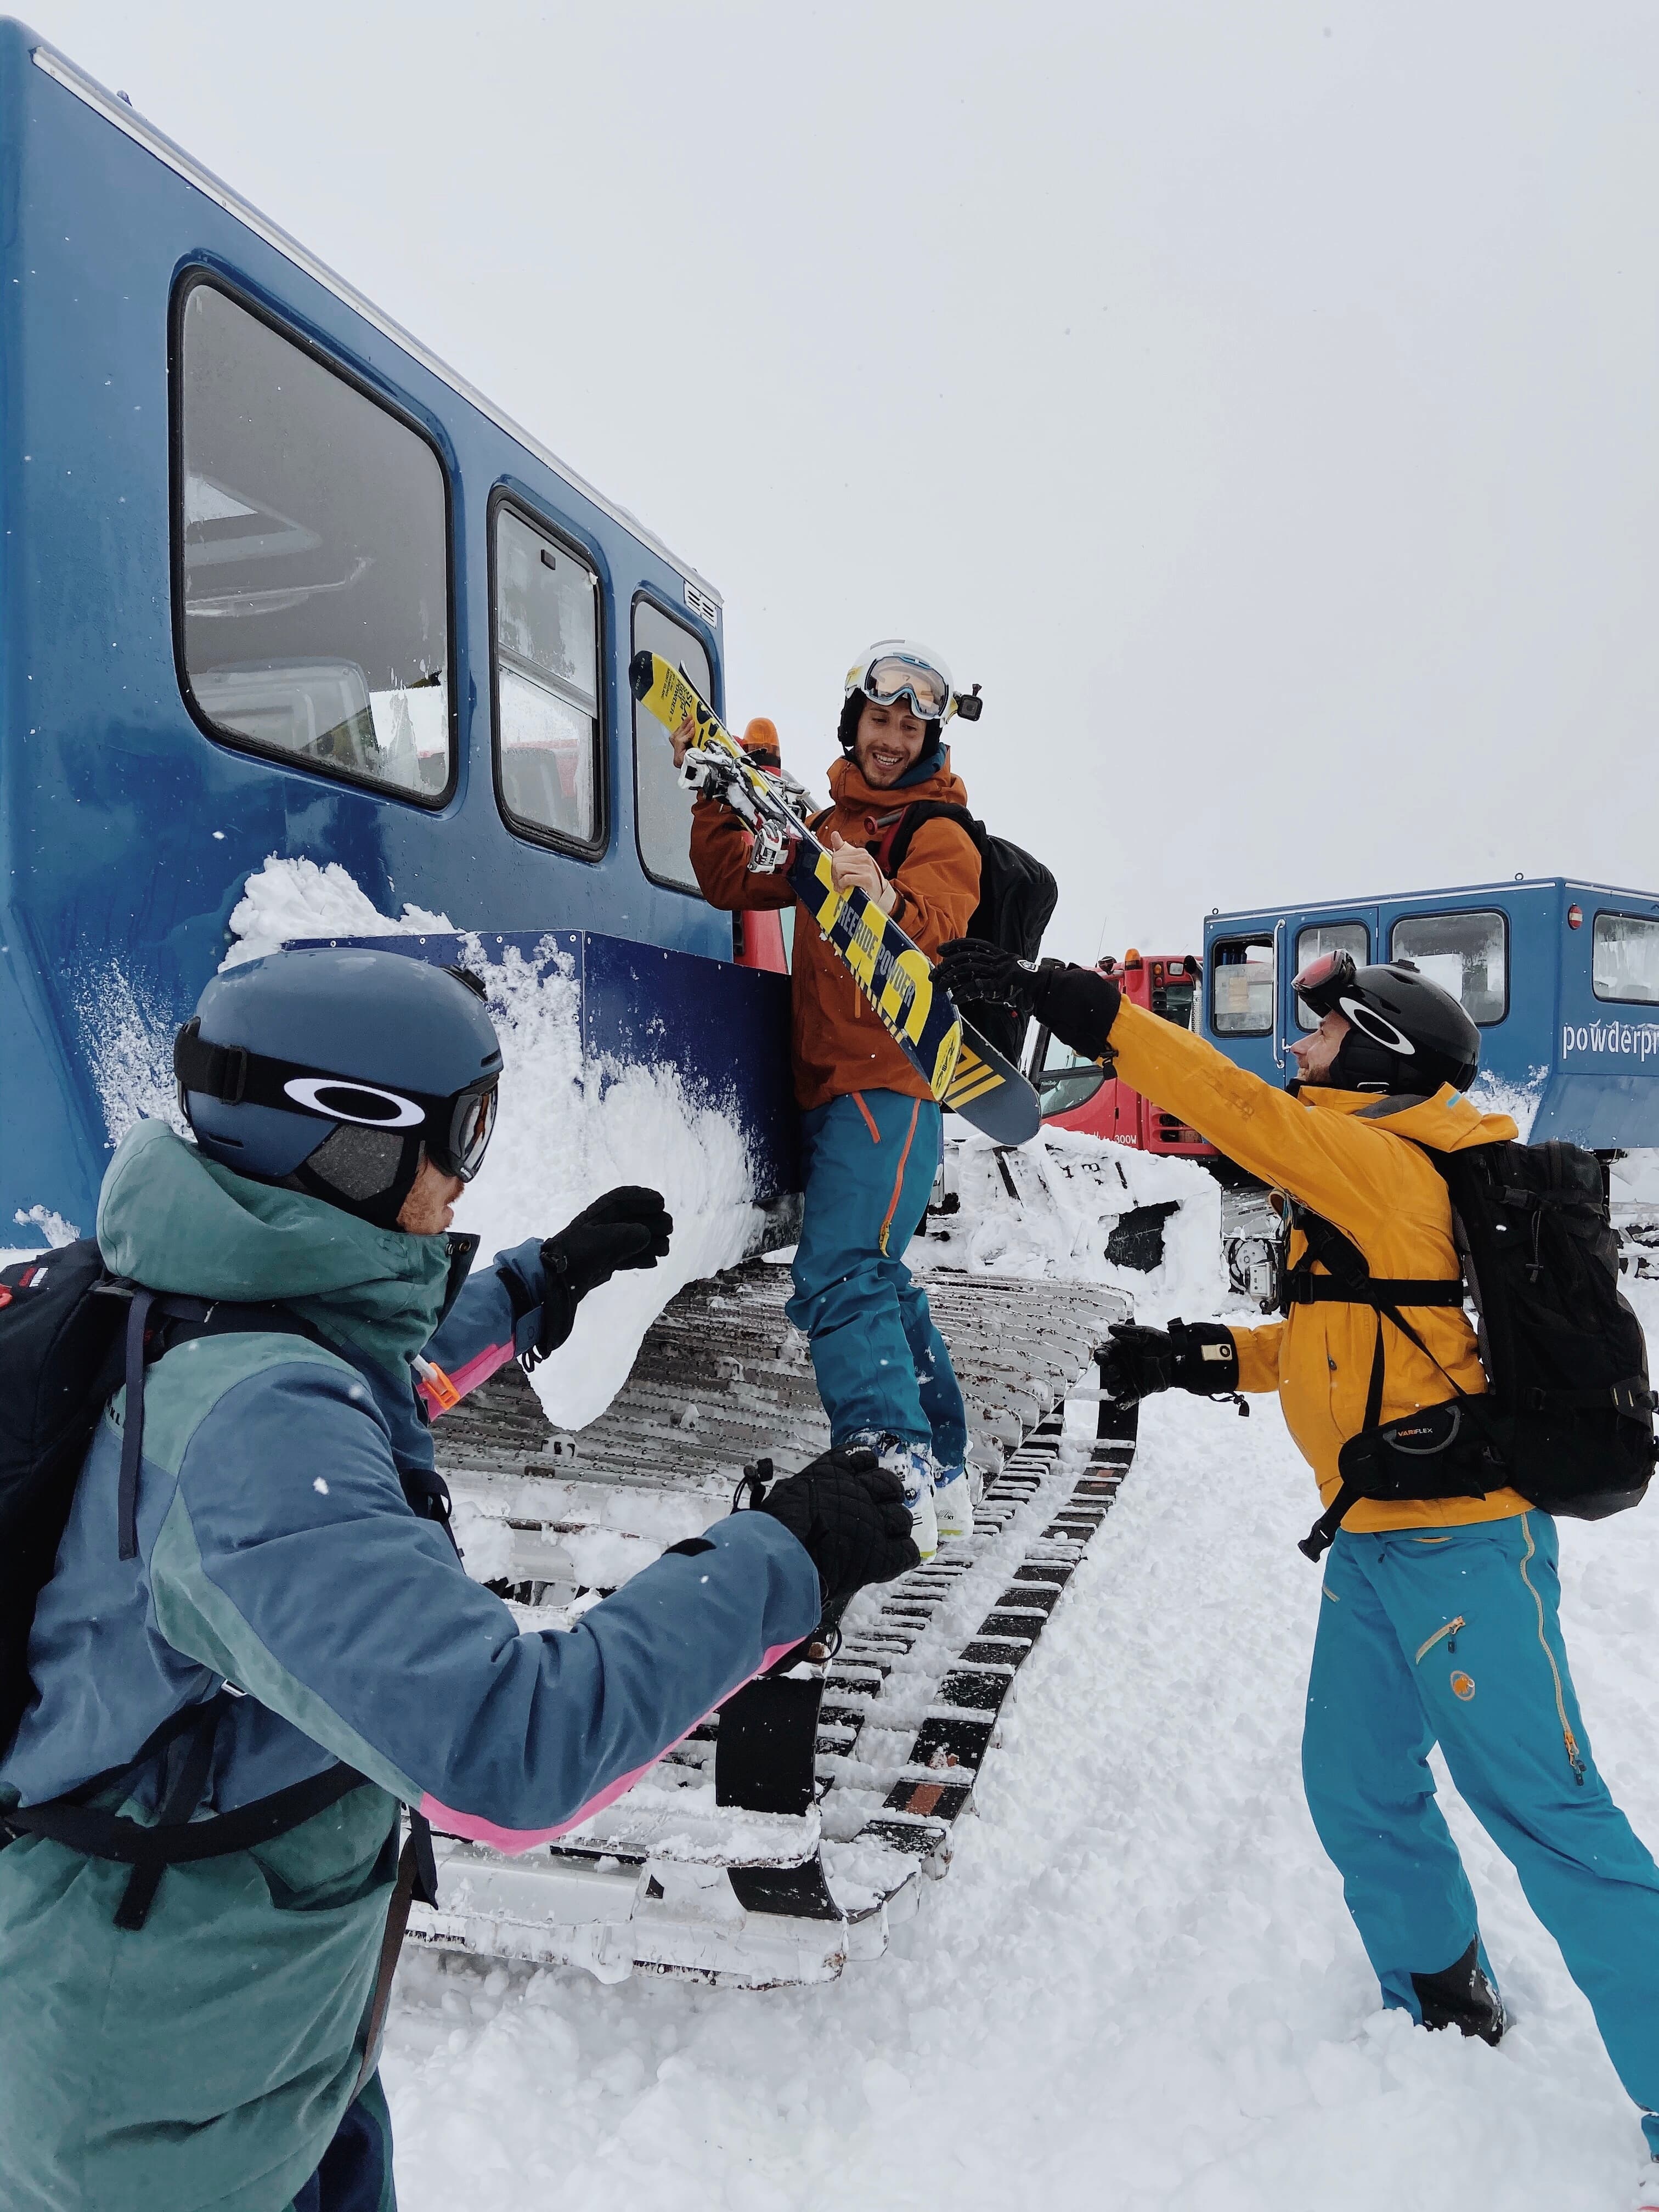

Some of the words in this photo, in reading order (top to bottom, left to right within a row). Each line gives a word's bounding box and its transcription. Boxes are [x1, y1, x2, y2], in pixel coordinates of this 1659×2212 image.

[669, 679, 681, 715] POWDER
[833, 895, 879, 960] FREERIDE
[874, 943, 916, 1008] POWDER
[1115, 1135, 1137, 1144] 300W
[1397, 1427, 1433, 1436] VARIFLEX
